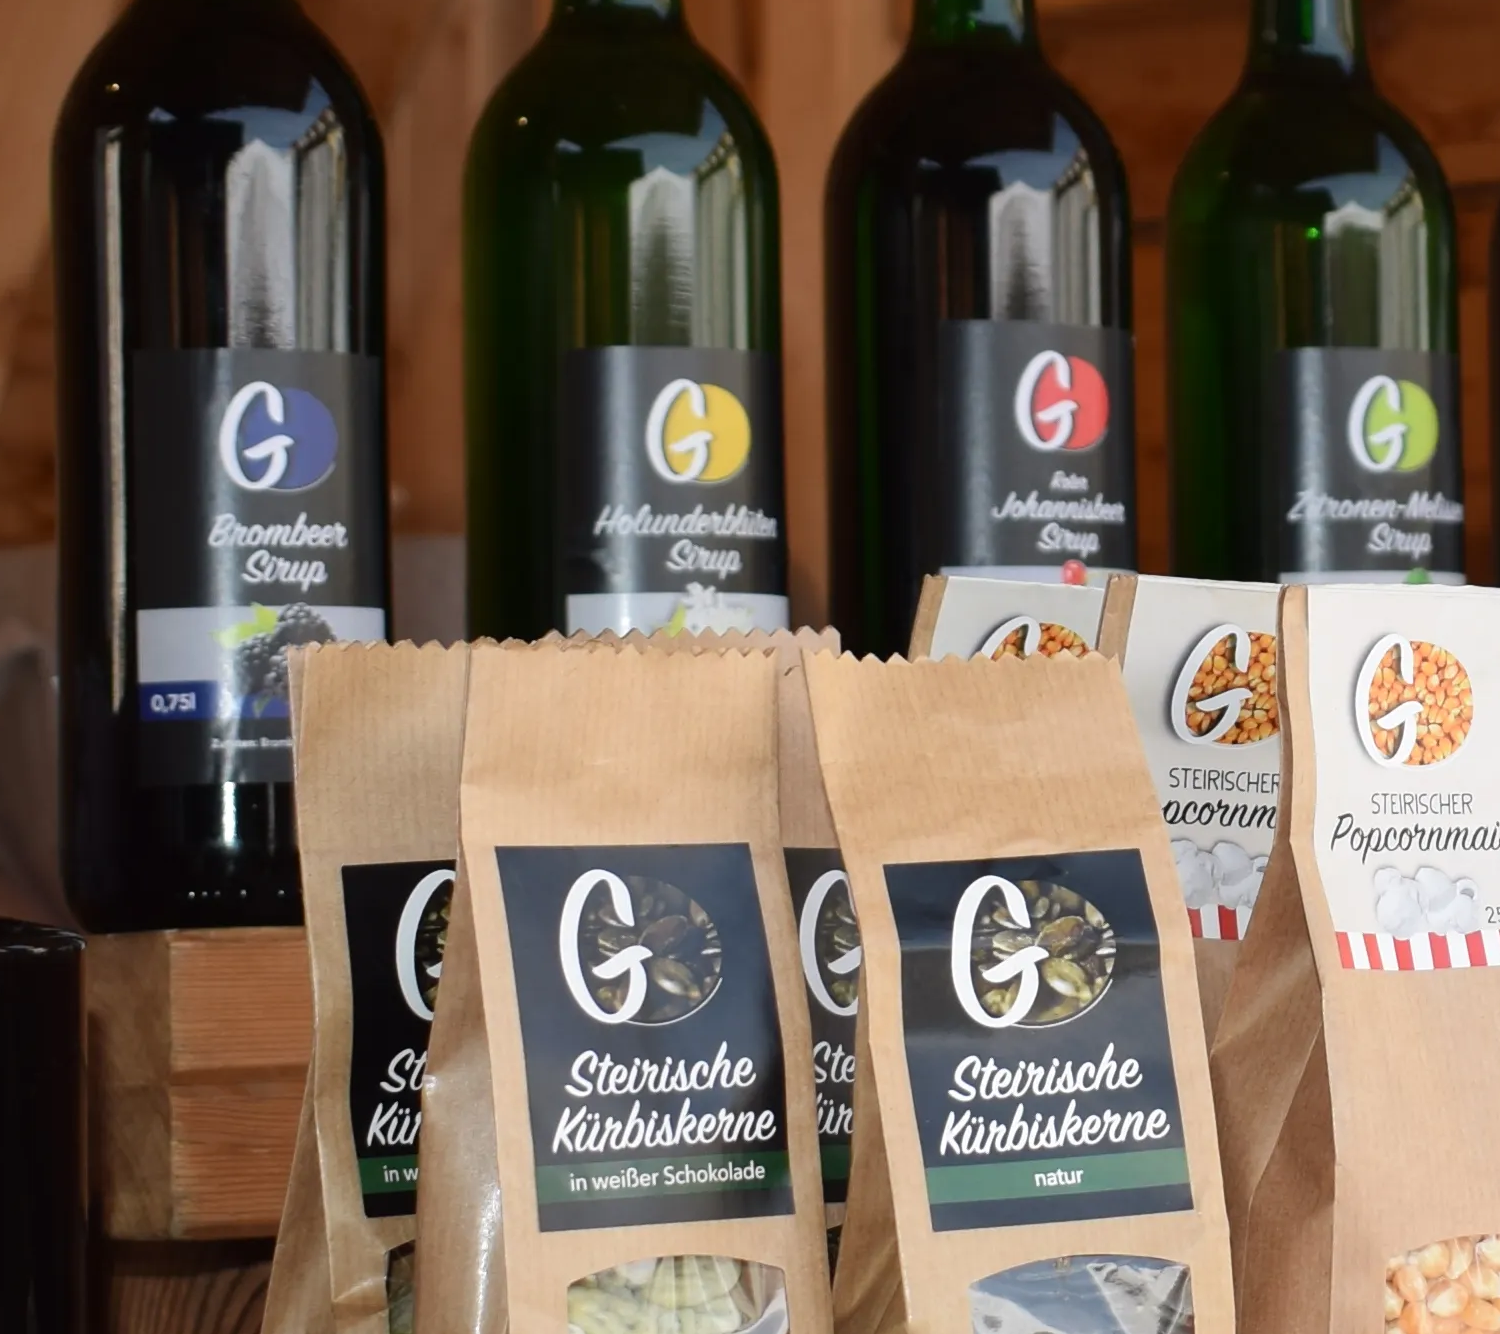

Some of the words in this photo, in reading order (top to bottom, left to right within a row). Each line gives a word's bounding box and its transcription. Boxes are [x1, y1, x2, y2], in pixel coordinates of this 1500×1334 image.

[646, 378, 713, 483] G
[1014, 350, 1076, 452] G
[1348, 375, 1405, 474] G
[218, 380, 294, 491] G
[209, 513, 350, 551] Brombeer
[665, 538, 743, 580] Sirup
[1036, 522, 1100, 558] Sirup
[1367, 522, 1433, 559] Sirup
[240, 549, 329, 587] Sirup
[150, 691, 196, 712] 0,75l
[1172, 623, 1253, 746] G
[1353, 632, 1425, 769] G
[1370, 792, 1474, 817] STEIRISCHER
[559, 869, 652, 1025] G
[950, 874, 1051, 1029] G
[562, 1041, 757, 1099] Steirische
[947, 1041, 1144, 1104] Steirische
[550, 1095, 778, 1155] Kürbiskerne
[938, 1099, 1172, 1158] Kürbiskerne
[569, 1170, 587, 1192] in
[591, 1165, 660, 1192] weißer
[663, 1158, 767, 1188] Schokolade
[1034, 1166, 1085, 1190] natur
